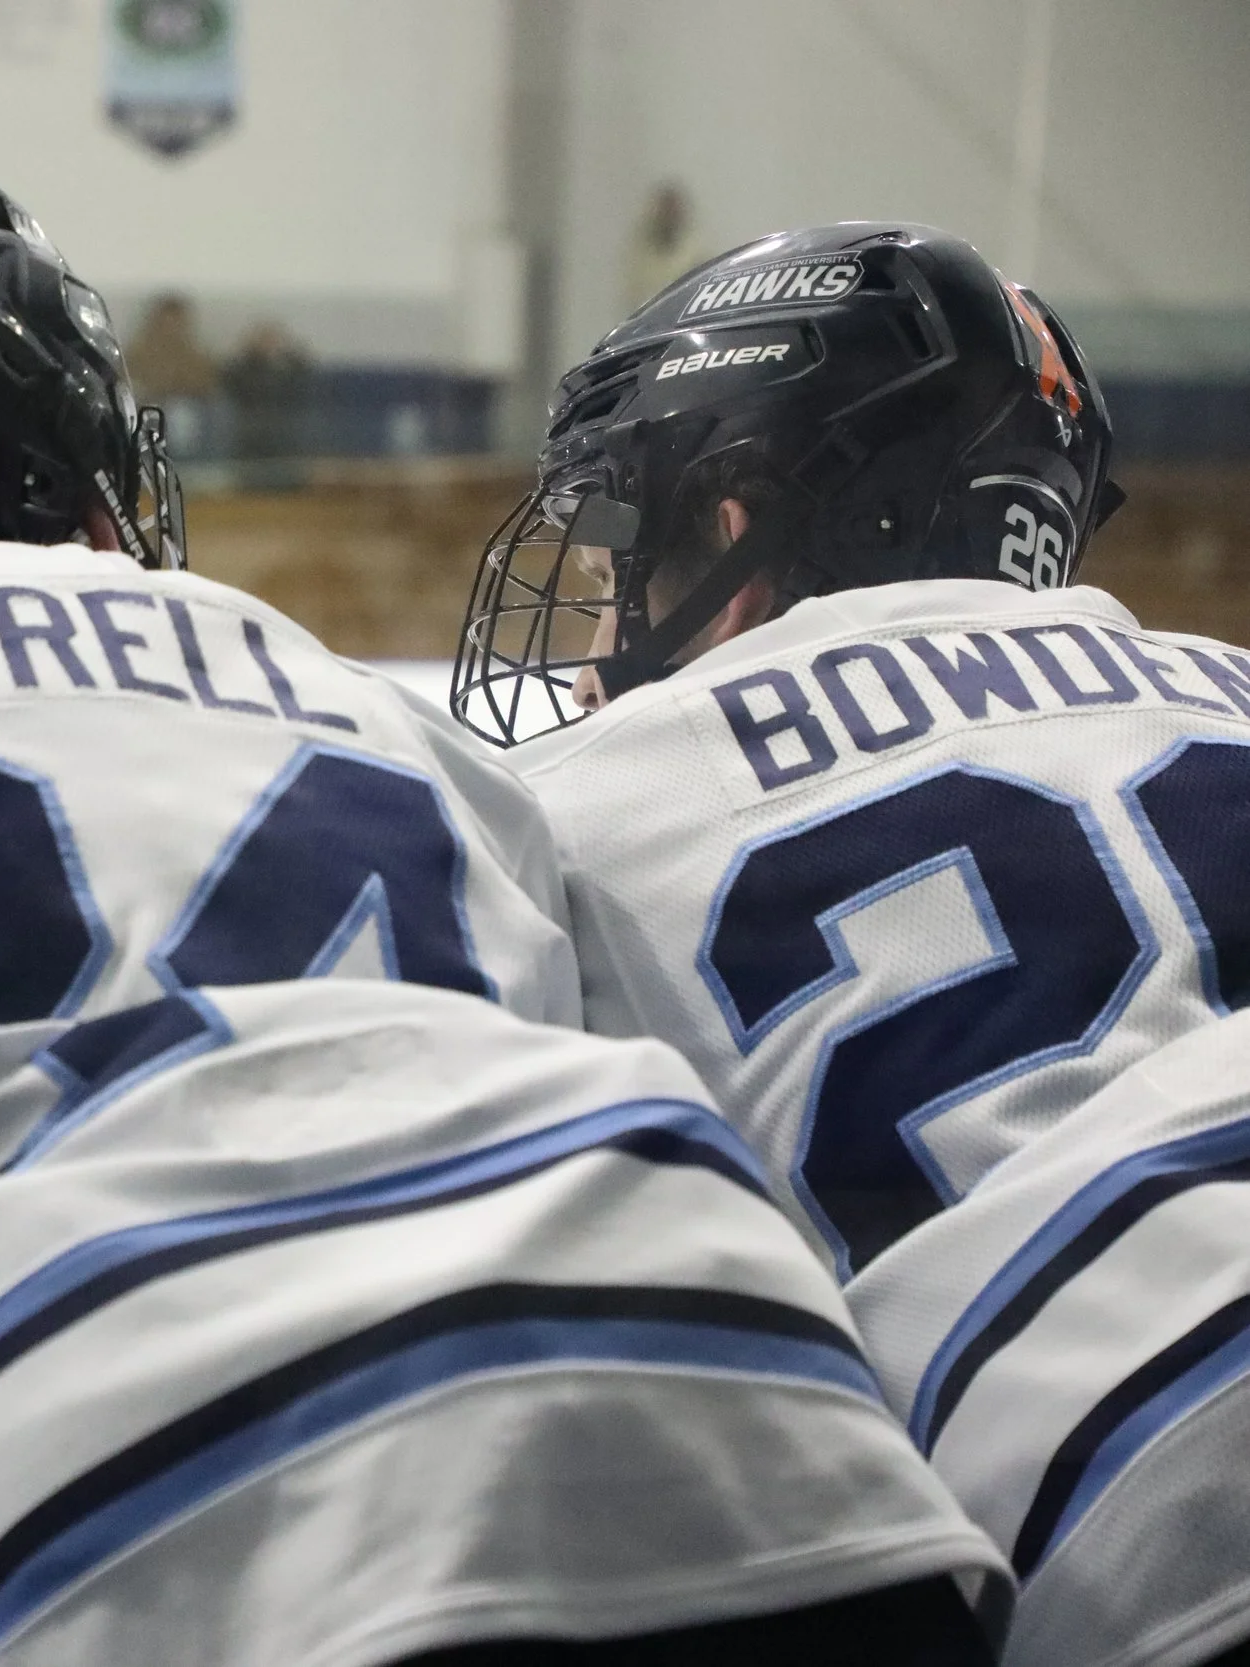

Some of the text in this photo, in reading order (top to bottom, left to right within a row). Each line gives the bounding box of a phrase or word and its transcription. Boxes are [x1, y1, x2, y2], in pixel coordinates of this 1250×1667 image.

[791, 255, 850, 267] UNIVERSITY
[687, 264, 857, 316] HAWKS
[998, 502, 1064, 594] 26
